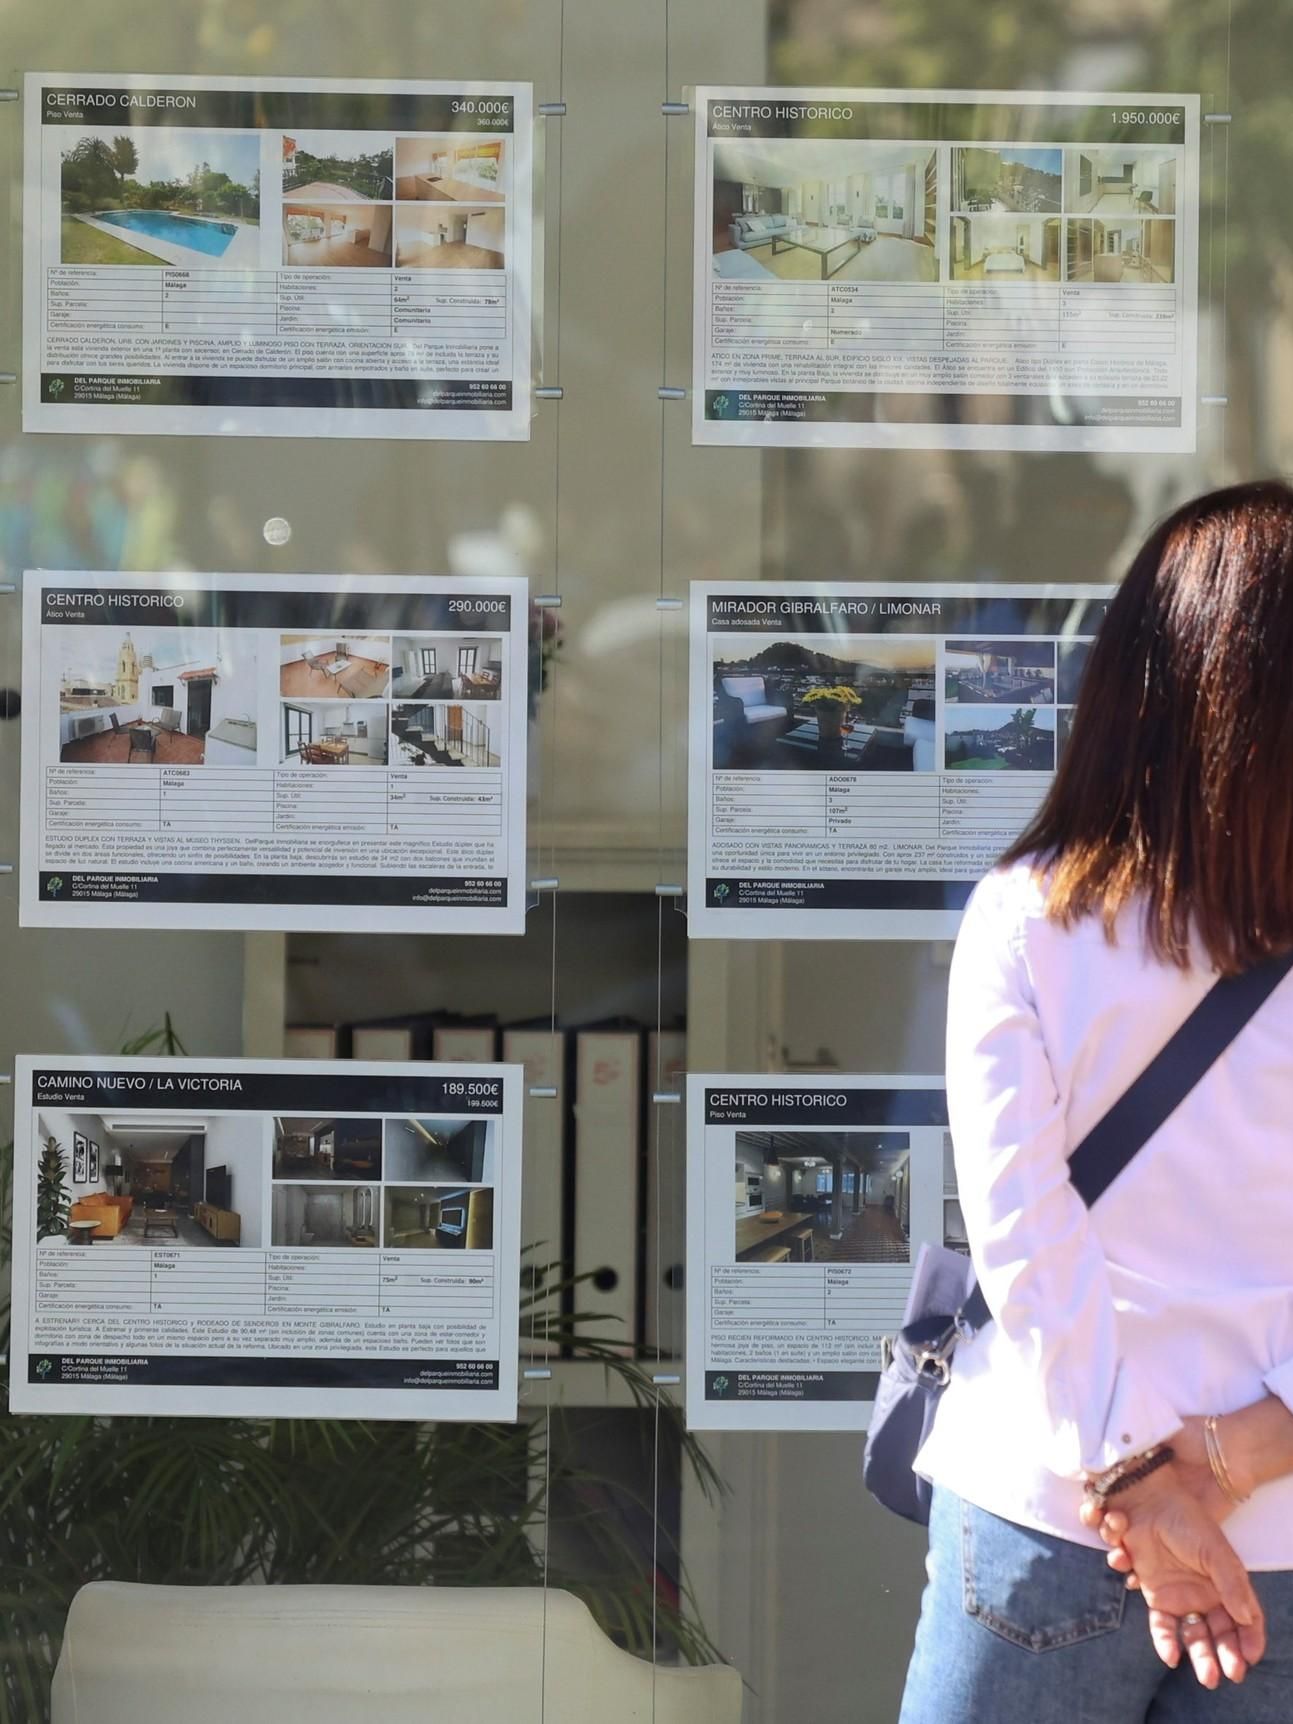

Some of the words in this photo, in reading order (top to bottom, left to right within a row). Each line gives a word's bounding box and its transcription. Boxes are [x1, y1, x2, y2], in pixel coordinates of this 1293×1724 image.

[46, 93, 116, 107] CERRADO
[119, 94, 197, 108] CALDERON
[451, 101, 509, 114] 340.000€
[46, 110, 62, 118] Piso
[63, 110, 84, 118] Venta
[712, 105, 772, 119] CENTRO
[775, 106, 853, 120] HISTORICO
[1110, 111, 1180, 125] 1.950.000€
[731, 123, 752, 131] Venta
[88, 377, 116, 386] PARQUE
[753, 394, 781, 402] PARQUE
[781, 394, 827, 402] INMOBILIARIA
[46, 593, 105, 606] CENTRO
[107, 594, 185, 607] HISTORICO
[448, 600, 506, 613] 290.000€
[711, 601, 777, 614] MIRADOR
[780, 601, 868, 614] GIBRALFARO
[878, 602, 942, 615] LIMONAR
[46, 608, 64, 618] Ático
[64, 610, 85, 618] Venta
[761, 618, 782, 626] Venta
[162, 779, 185, 788] Málaga
[828, 786, 850, 794] Málaga
[86, 875, 114, 884] PARQUE
[753, 882, 780, 890] PARQUE
[37, 1075, 93, 1089] CAMINO
[96, 1076, 147, 1090] NUEVO
[157, 1078, 175, 1090] LA
[177, 1078, 243, 1091] VICTORIA
[441, 1082, 499, 1095] 189.500€
[37, 1092, 63, 1100] Estudio
[64, 1093, 85, 1101] Venta
[709, 1094, 768, 1106] CENTRO
[771, 1094, 847, 1106] HISTORICO
[709, 1110, 725, 1118] Piso
[153, 1261, 176, 1270] Málaga
[76, 1358, 104, 1366] PARQUE
[752, 1374, 779, 1382] PARQUE
